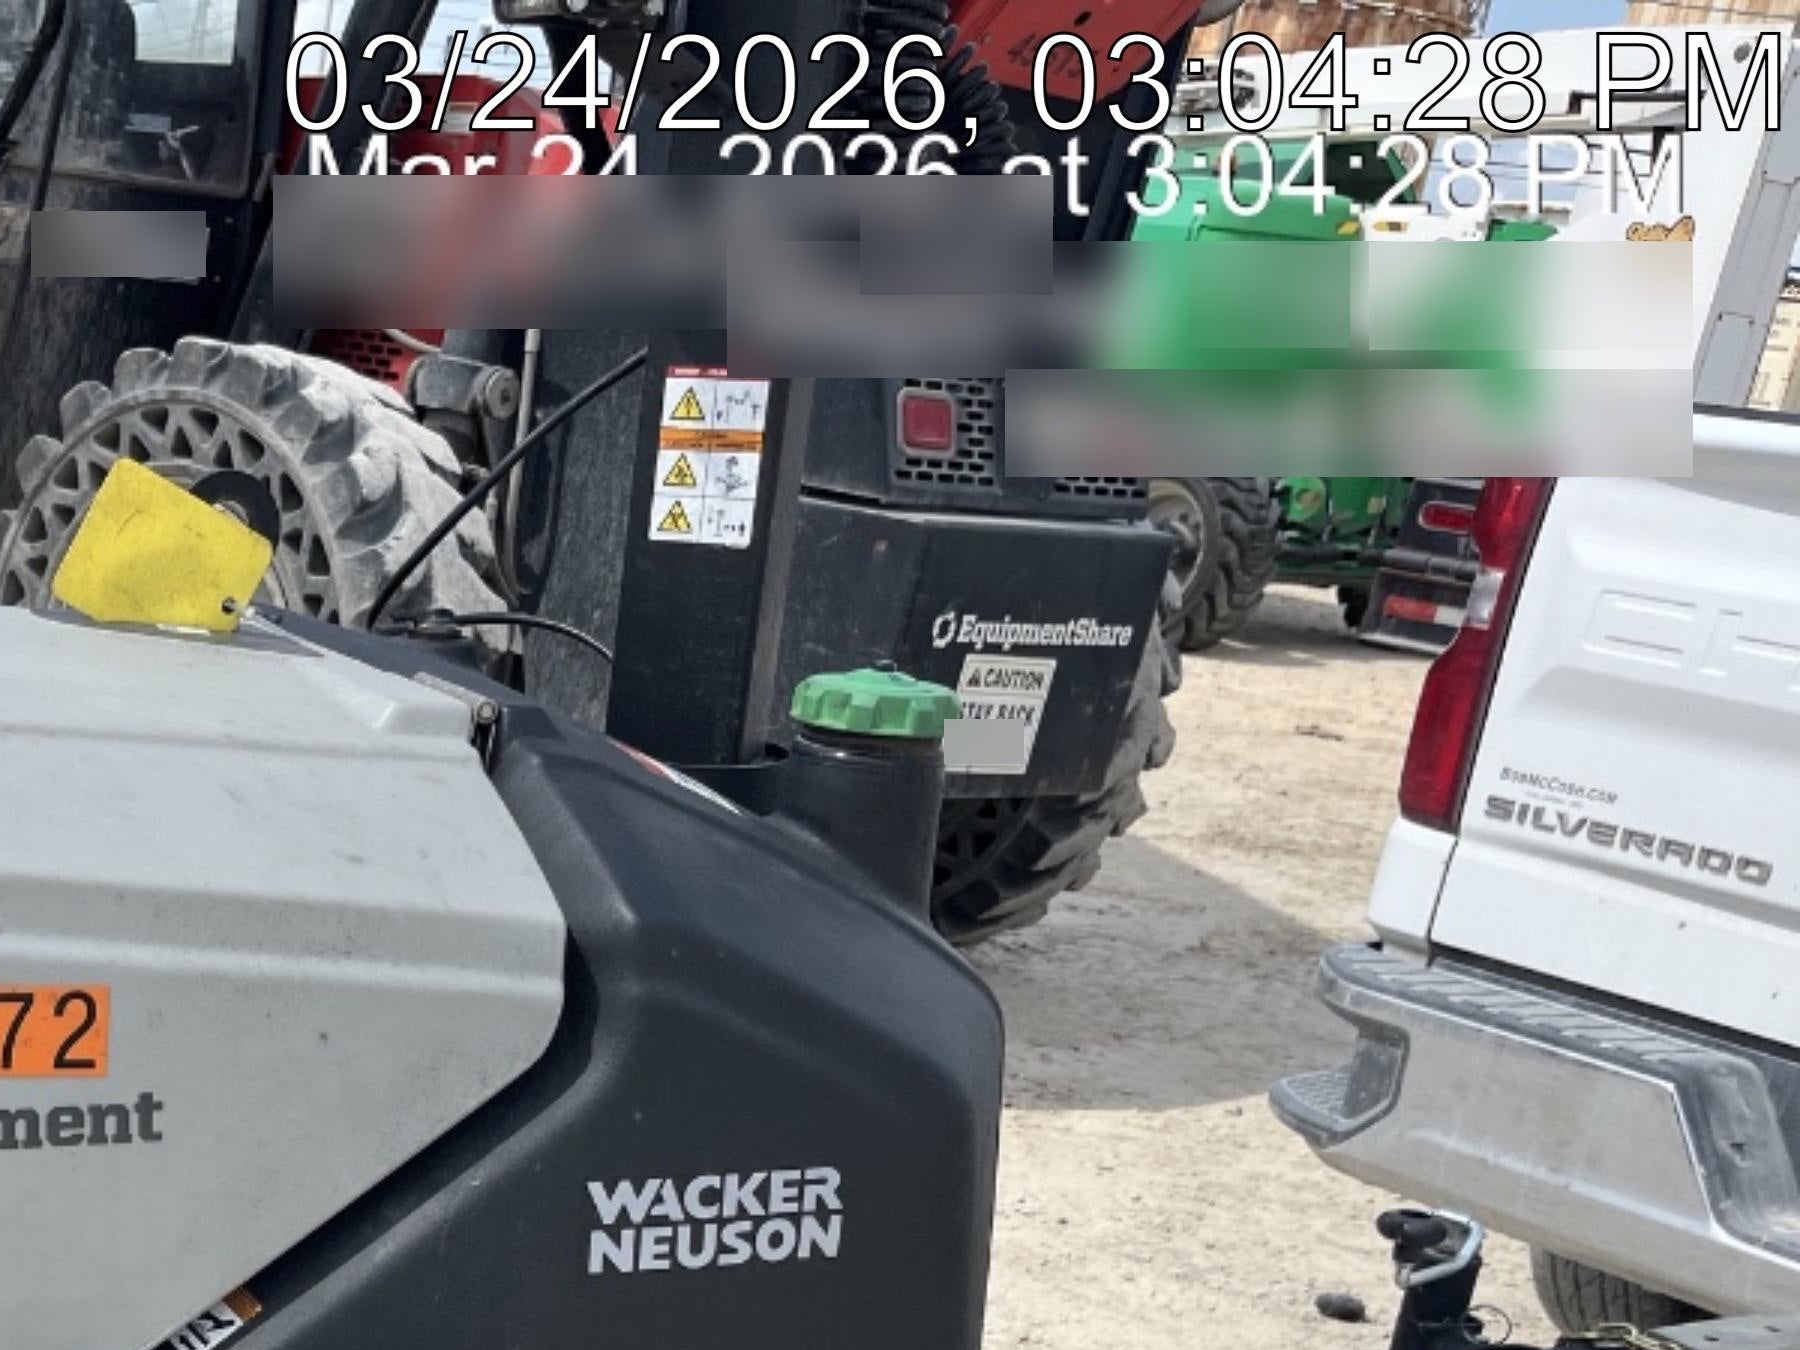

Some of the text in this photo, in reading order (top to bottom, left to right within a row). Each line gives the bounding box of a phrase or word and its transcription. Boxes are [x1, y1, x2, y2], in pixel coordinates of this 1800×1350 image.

[956, 613, 1134, 652] EquipmentShare
[983, 667, 1045, 691] CAUTION
[1483, 793, 1774, 887] SILVERADO
[586, 1165, 845, 1226] WACKER
[586, 1213, 845, 1276] NEUSON
